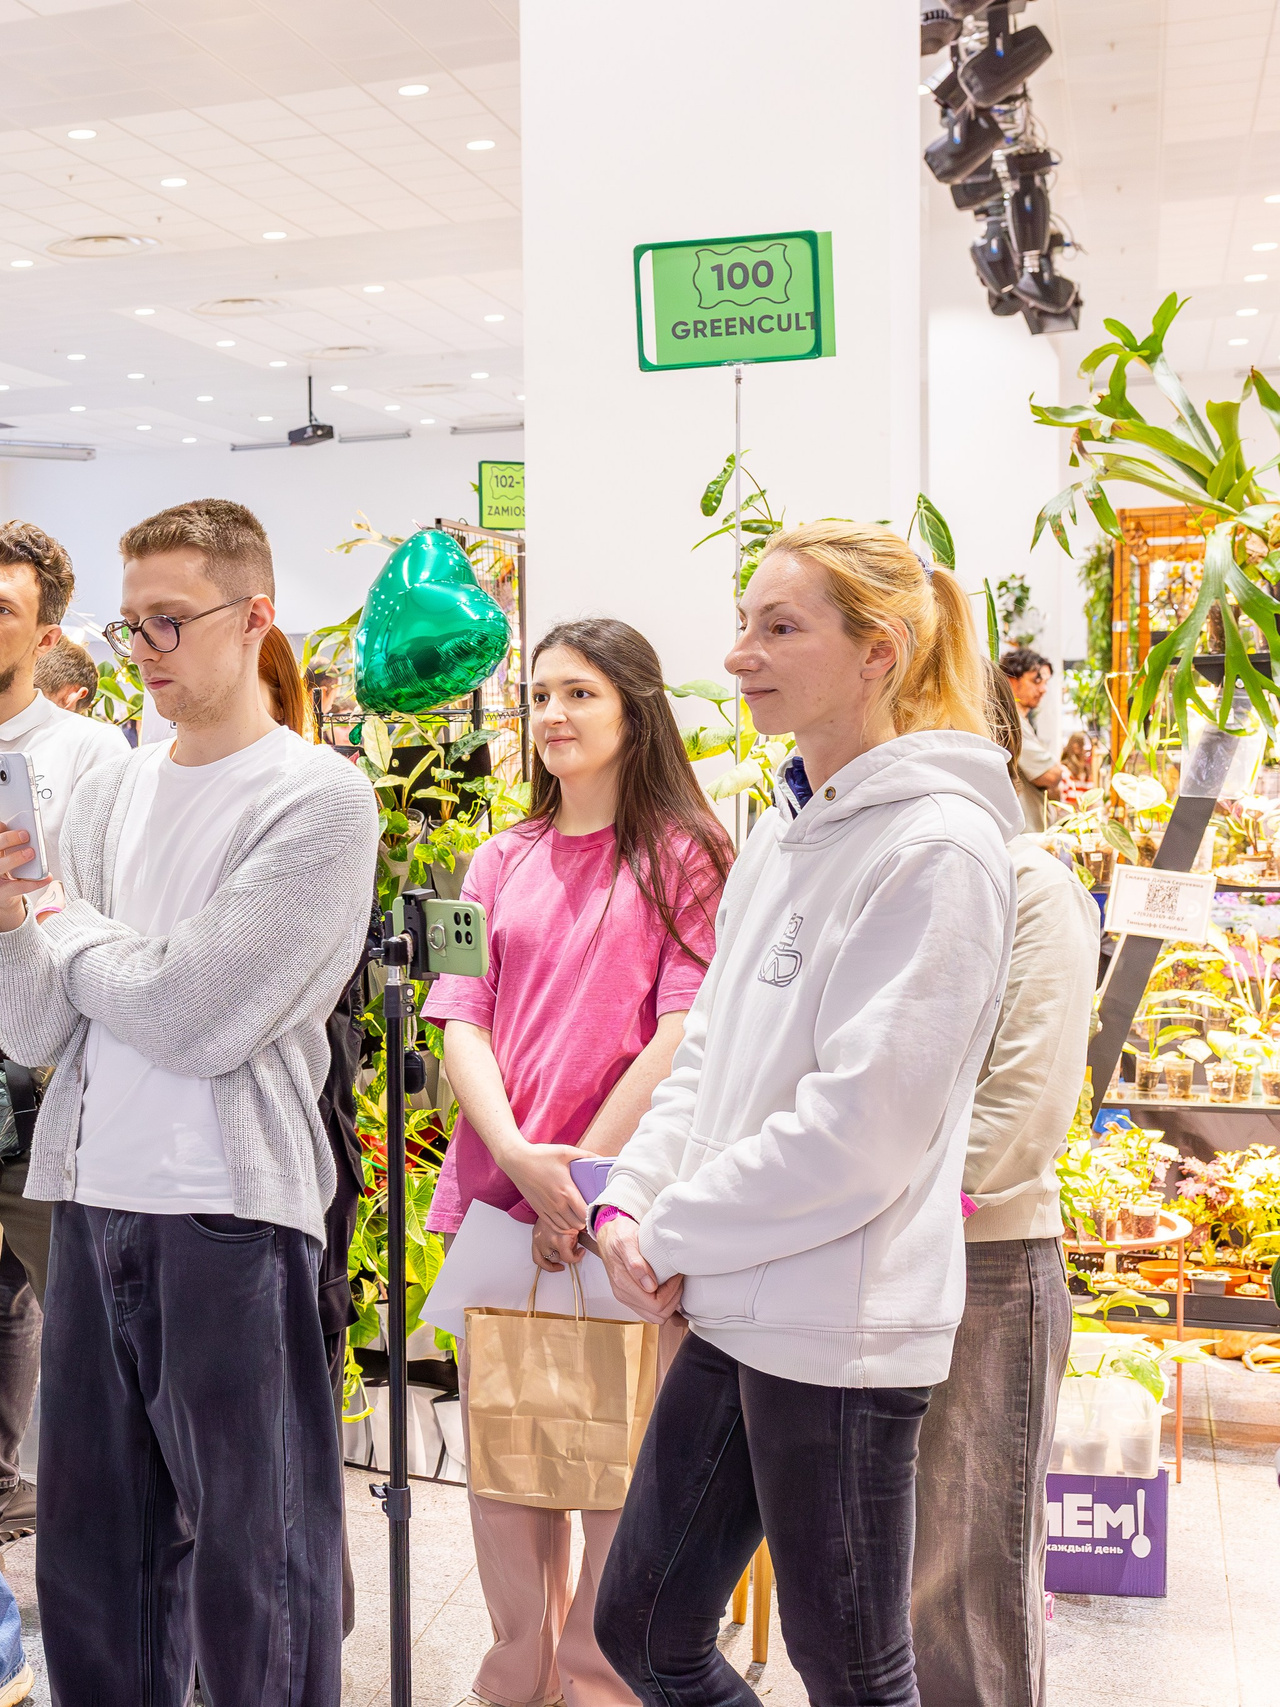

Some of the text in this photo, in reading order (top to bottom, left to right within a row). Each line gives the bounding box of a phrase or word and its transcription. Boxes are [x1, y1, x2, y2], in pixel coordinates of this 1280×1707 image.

[710, 260, 774, 291] 100
[671, 311, 816, 340] GREENCULT
[1046, 1543, 1124, 1555] каждый день
